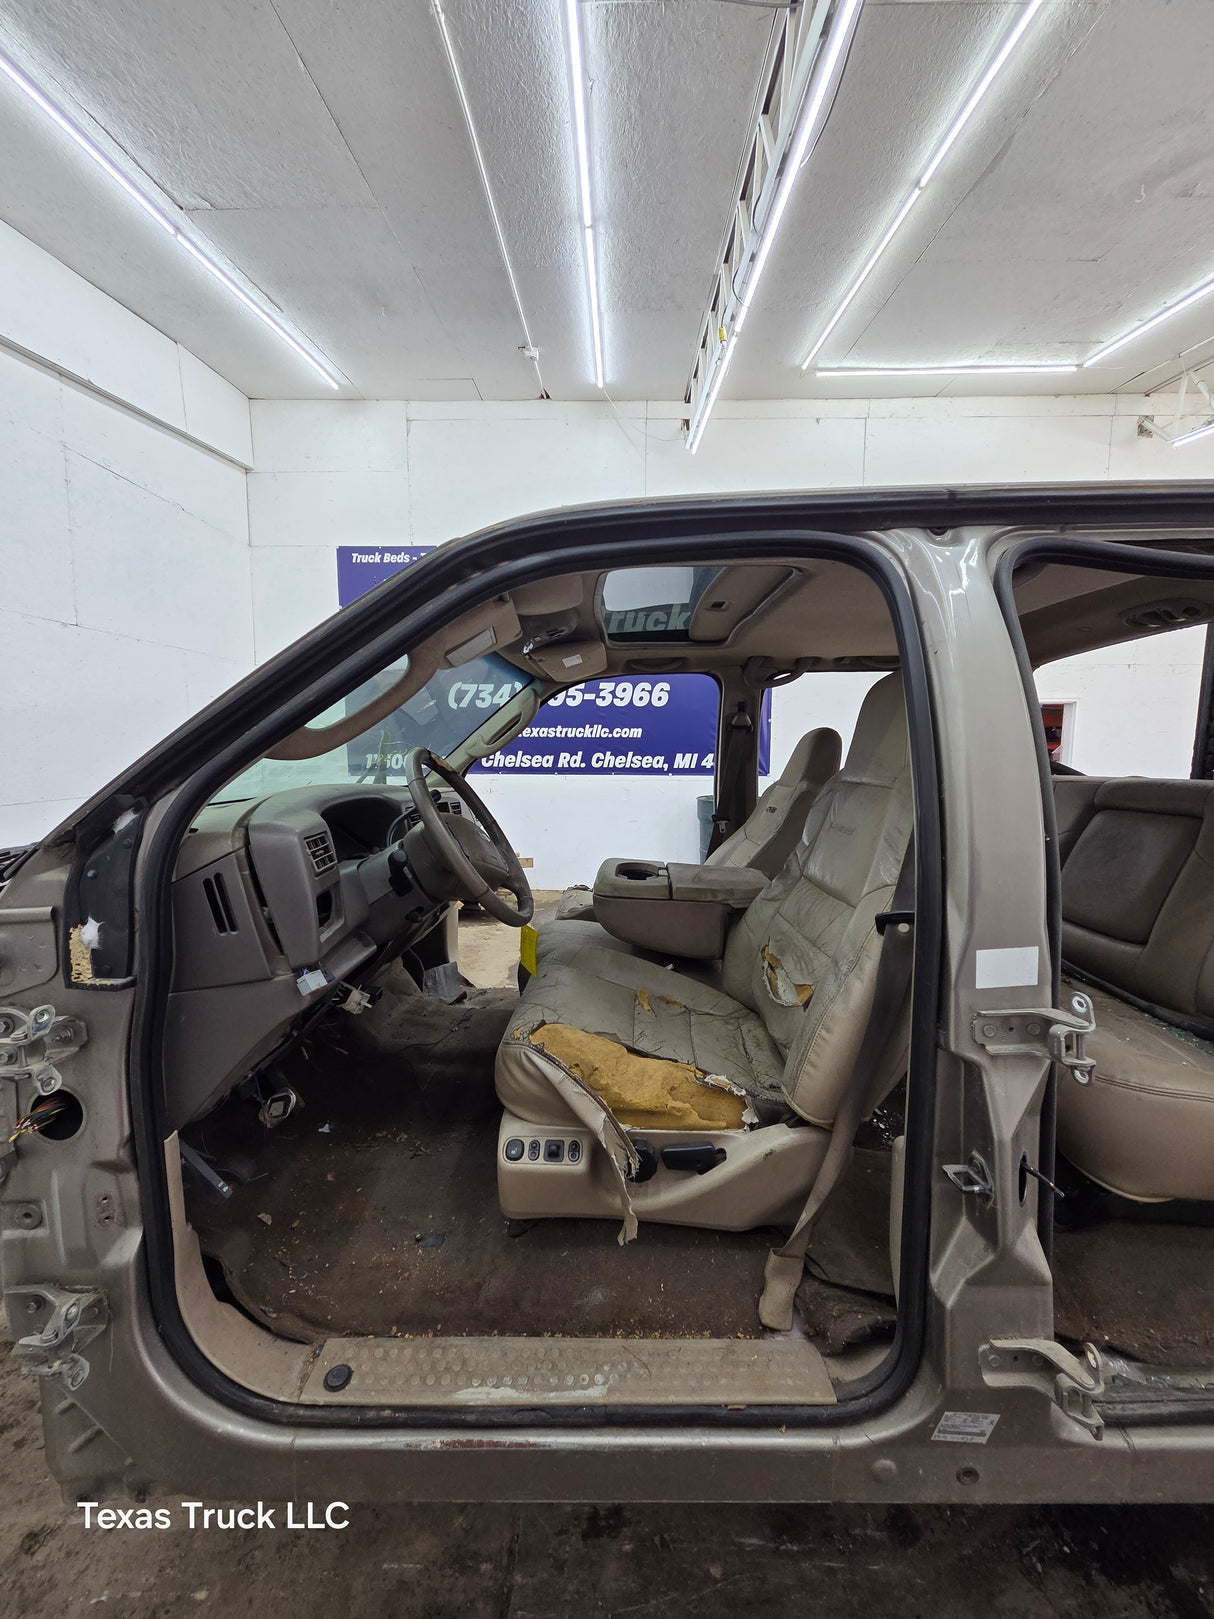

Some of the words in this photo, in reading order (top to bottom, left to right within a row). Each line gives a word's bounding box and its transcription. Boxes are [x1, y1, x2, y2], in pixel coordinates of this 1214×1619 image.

[351, 552, 381, 563] Truck
[383, 552, 410, 564] Beds
[602, 603, 691, 633] ruck
[518, 724, 643, 738] exastruckllc.com
[482, 750, 554, 768] Chelsea
[558, 750, 586, 768] Rd.
[591, 751, 668, 771] Chelsea,
[674, 753, 698, 769] MI
[701, 753, 715, 768] 4
